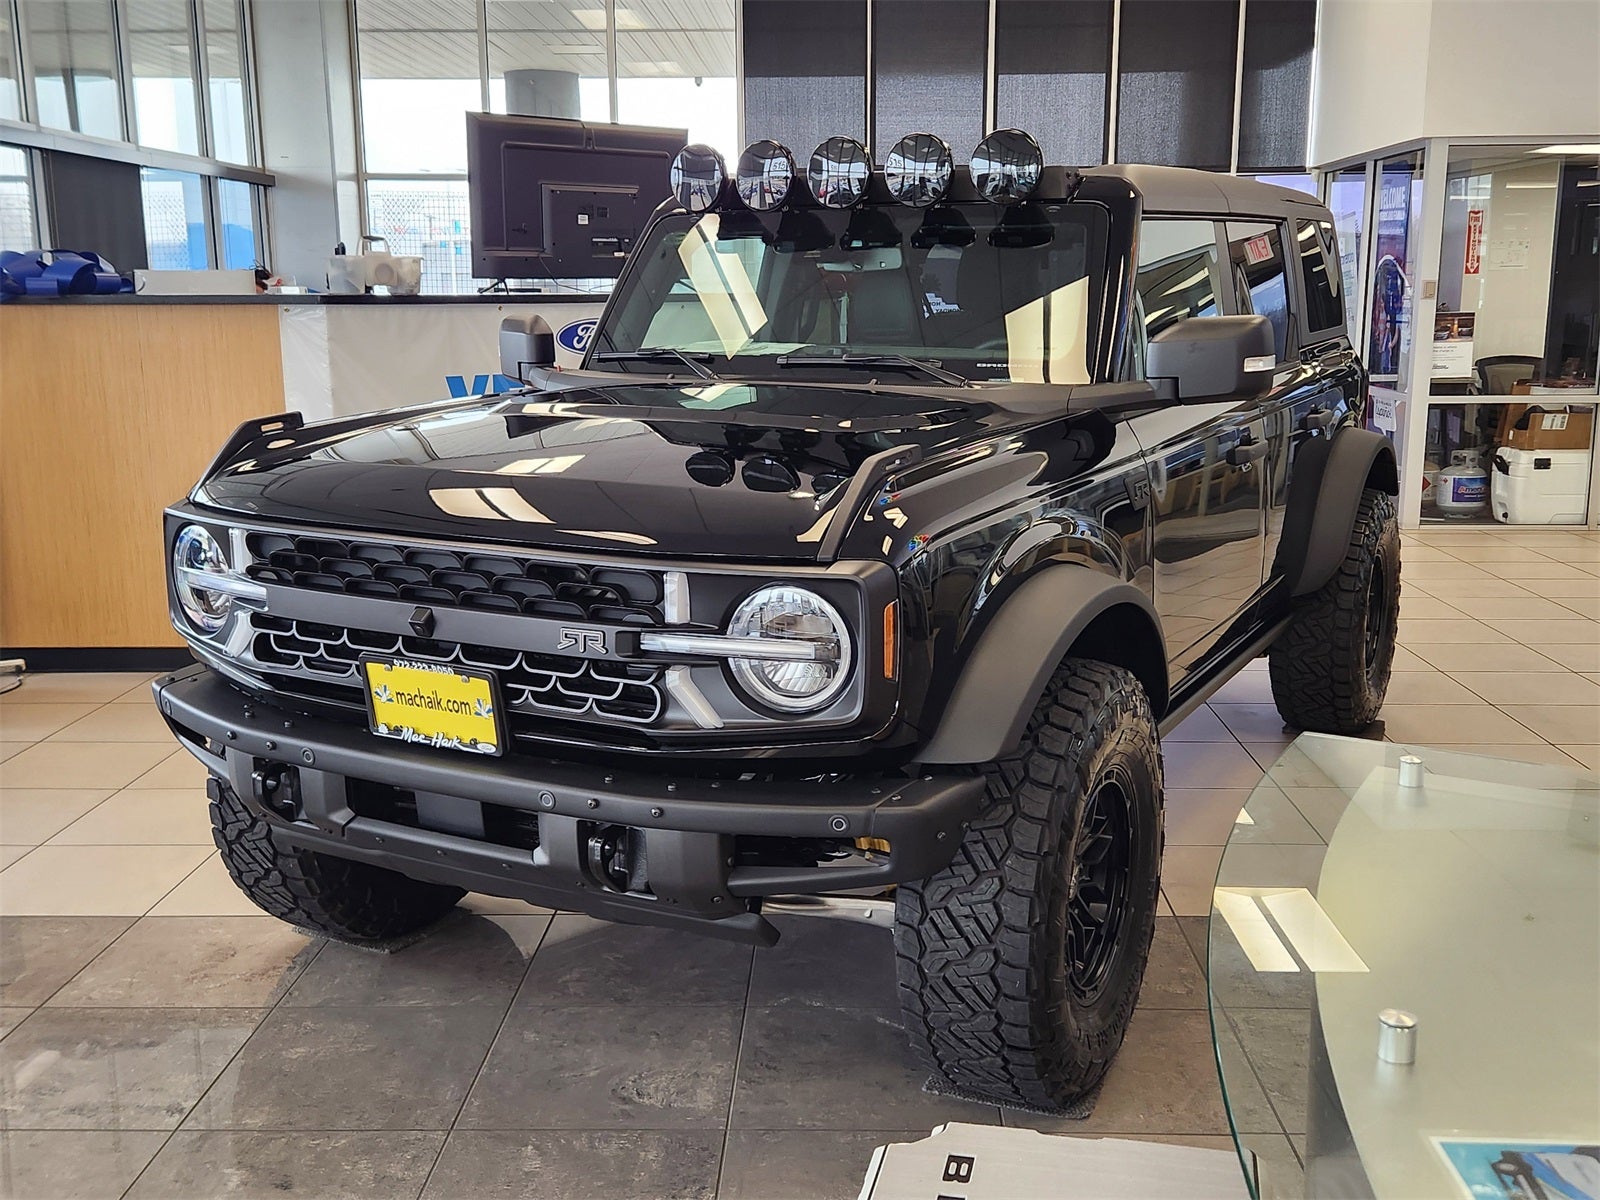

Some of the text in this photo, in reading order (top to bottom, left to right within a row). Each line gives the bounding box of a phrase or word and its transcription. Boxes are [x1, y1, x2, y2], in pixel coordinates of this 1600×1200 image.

[395, 687, 472, 716] machaik.com
[401, 726, 463, 749] Mac Haik
